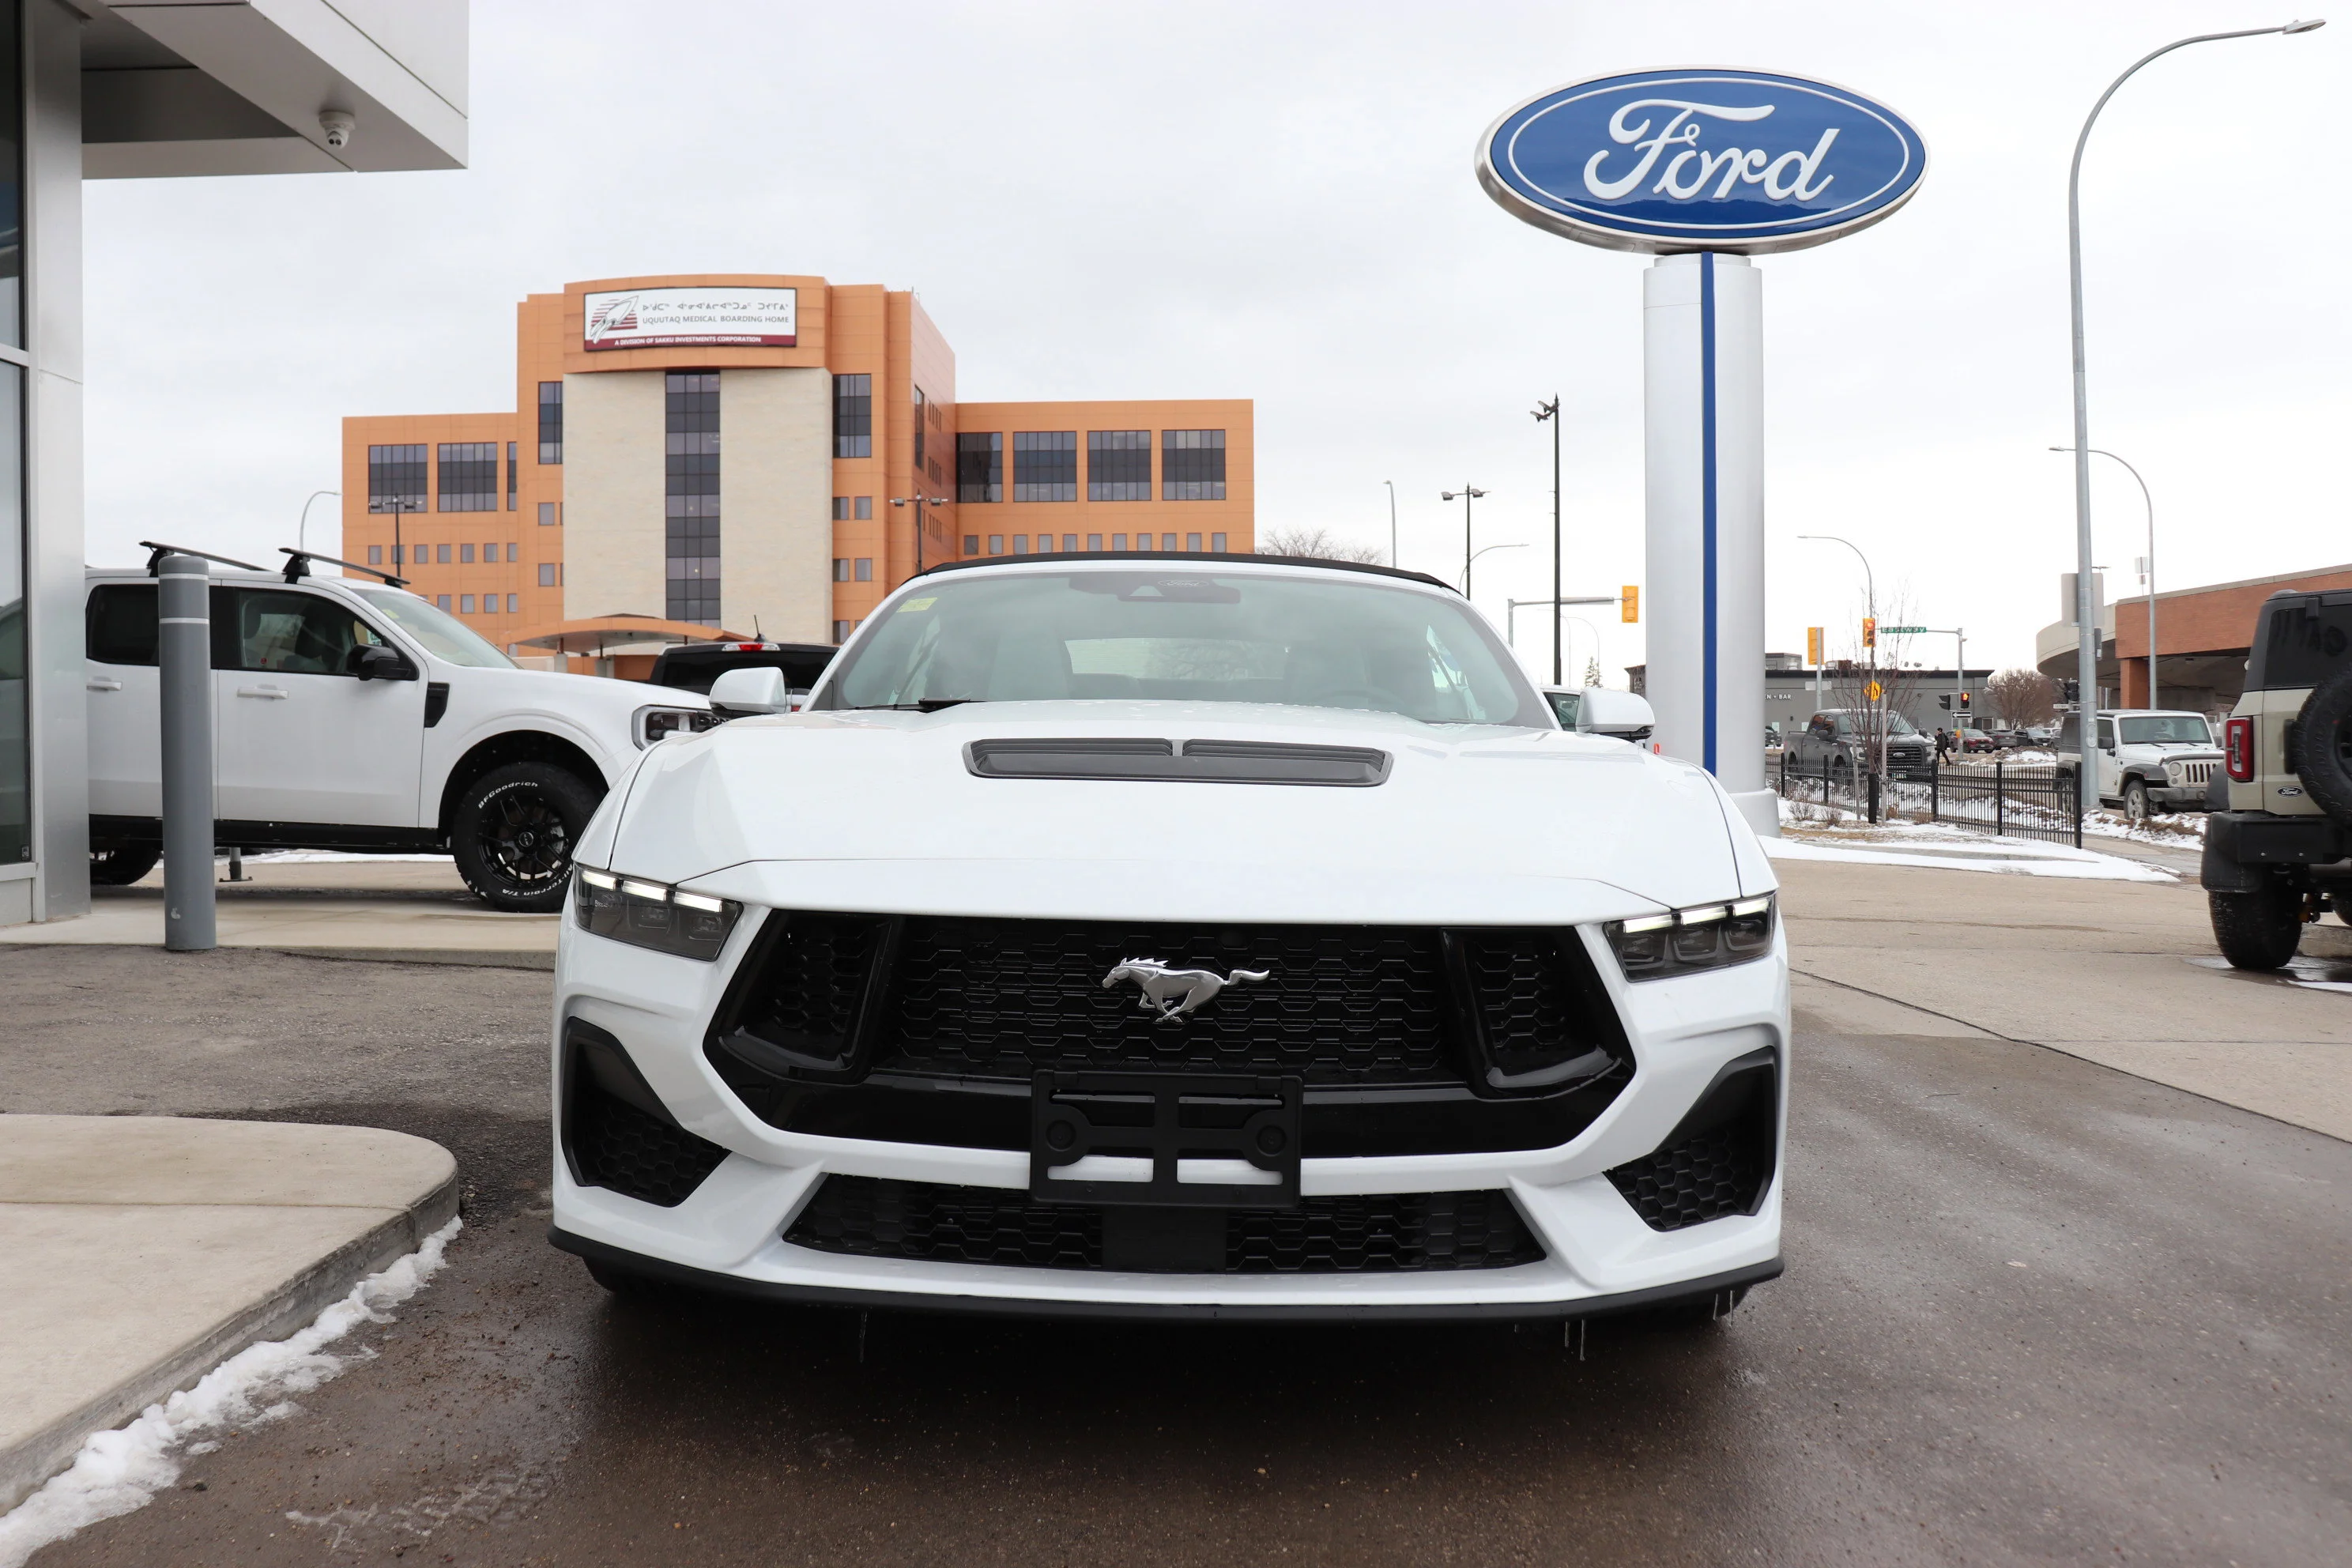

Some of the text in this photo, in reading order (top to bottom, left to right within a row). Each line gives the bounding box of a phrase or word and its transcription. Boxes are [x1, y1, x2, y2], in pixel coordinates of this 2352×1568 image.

[1584, 99, 1840, 201] Ford
[643, 316, 681, 325] UQUUTAQ
[478, 782, 538, 809] BFGoodrich
